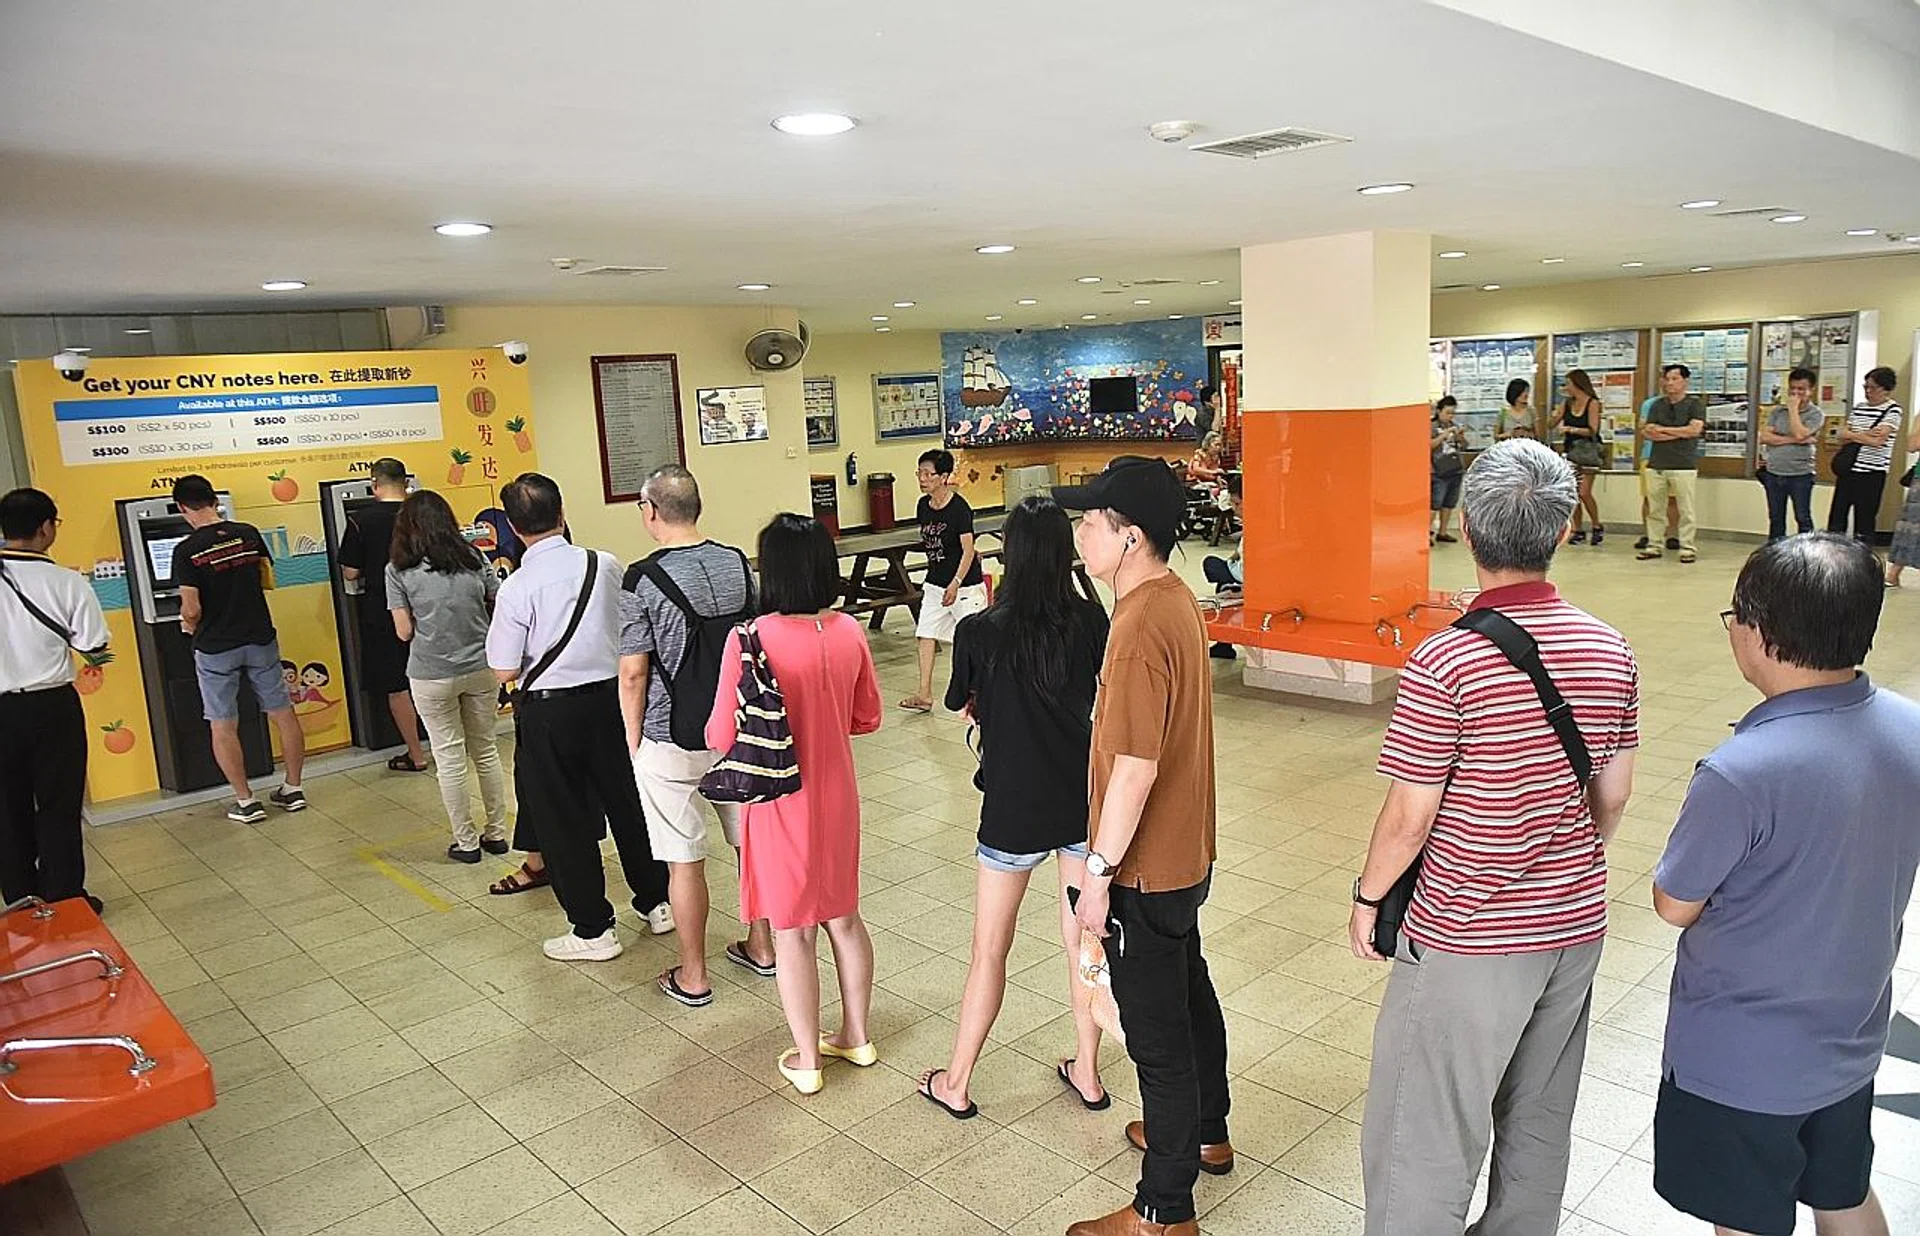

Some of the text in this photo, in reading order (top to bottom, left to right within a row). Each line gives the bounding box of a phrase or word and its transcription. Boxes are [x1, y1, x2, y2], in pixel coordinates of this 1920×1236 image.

[329, 366, 412, 383] 在此提取新钞
[84, 371, 324, 396] Get your CNY notes here.
[178, 399, 224, 410] Available
[225, 399, 236, 408] at
[236, 397, 254, 407] this
[87, 424, 126, 435] S$100
[173, 421, 187, 430] 50
[189, 420, 211, 431] pcs)
[92, 446, 129, 457] S$300
[178, 442, 190, 451] 30
[192, 441, 213, 451] pcs)
